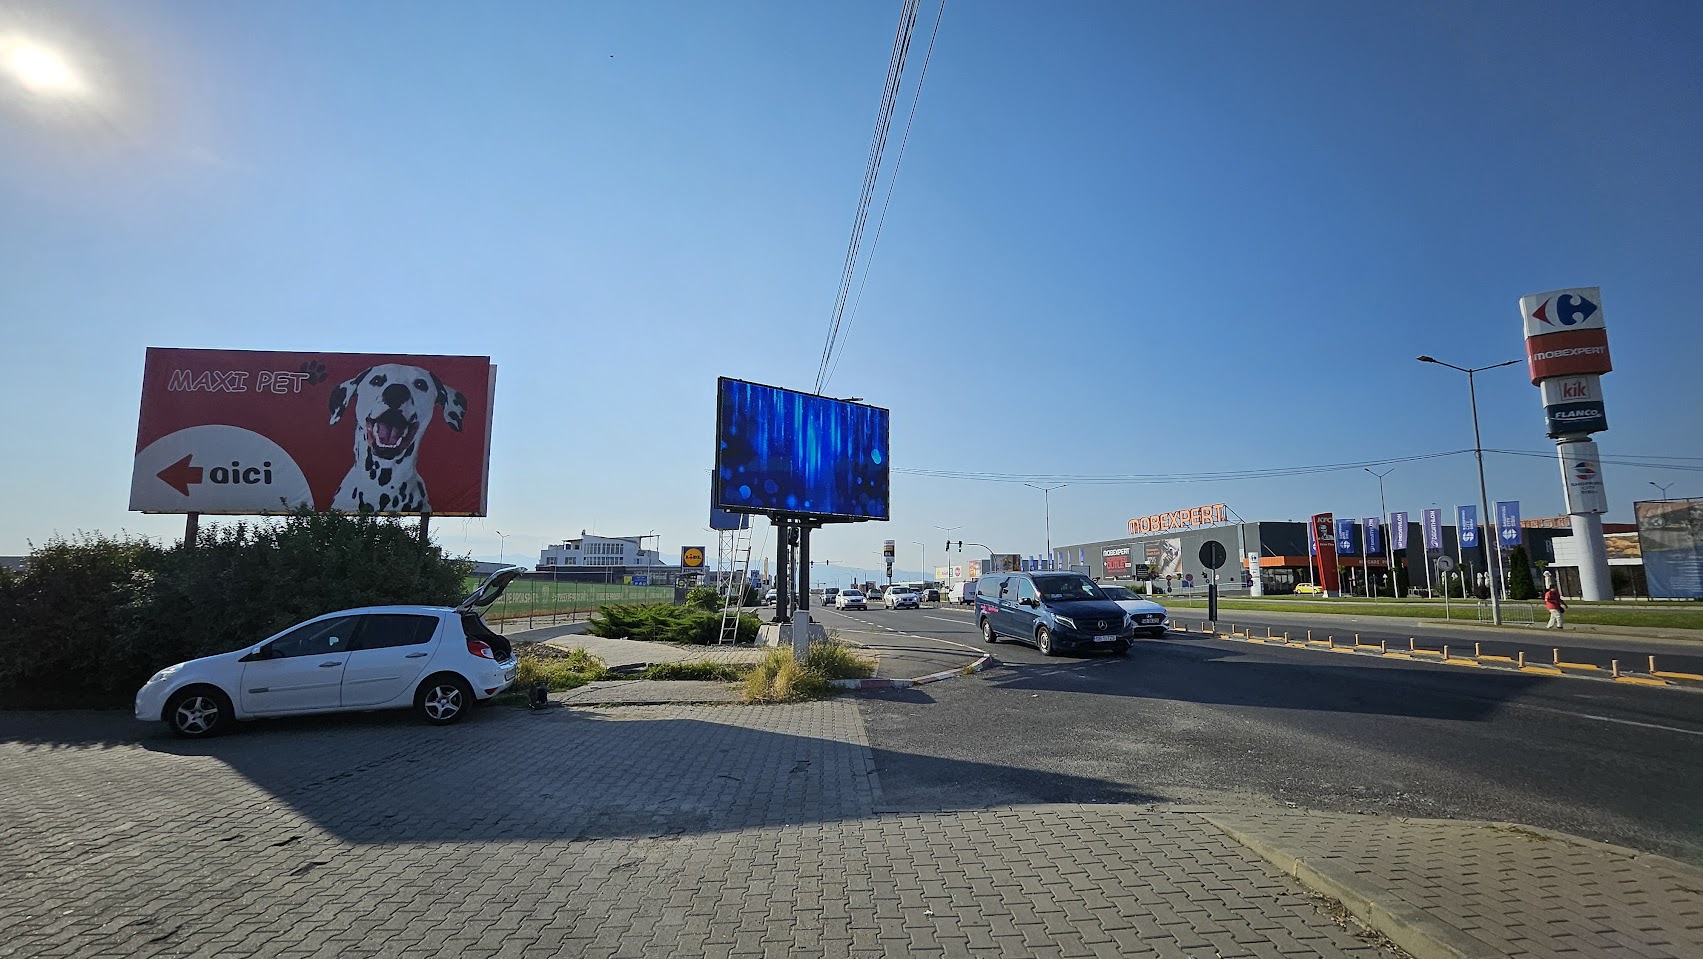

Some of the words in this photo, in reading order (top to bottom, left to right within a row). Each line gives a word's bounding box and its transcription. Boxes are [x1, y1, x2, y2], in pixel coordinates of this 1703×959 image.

[1534, 347, 1605, 360] MOBEXPERT
[168, 369, 249, 392] MAXI
[256, 370, 310, 394] PET
[1555, 409, 1598, 419] FLANCO
[209, 460, 272, 485] aici
[1128, 503, 1225, 534] MOBEXPERT
[1103, 548, 1130, 557] MOBEXPERT
